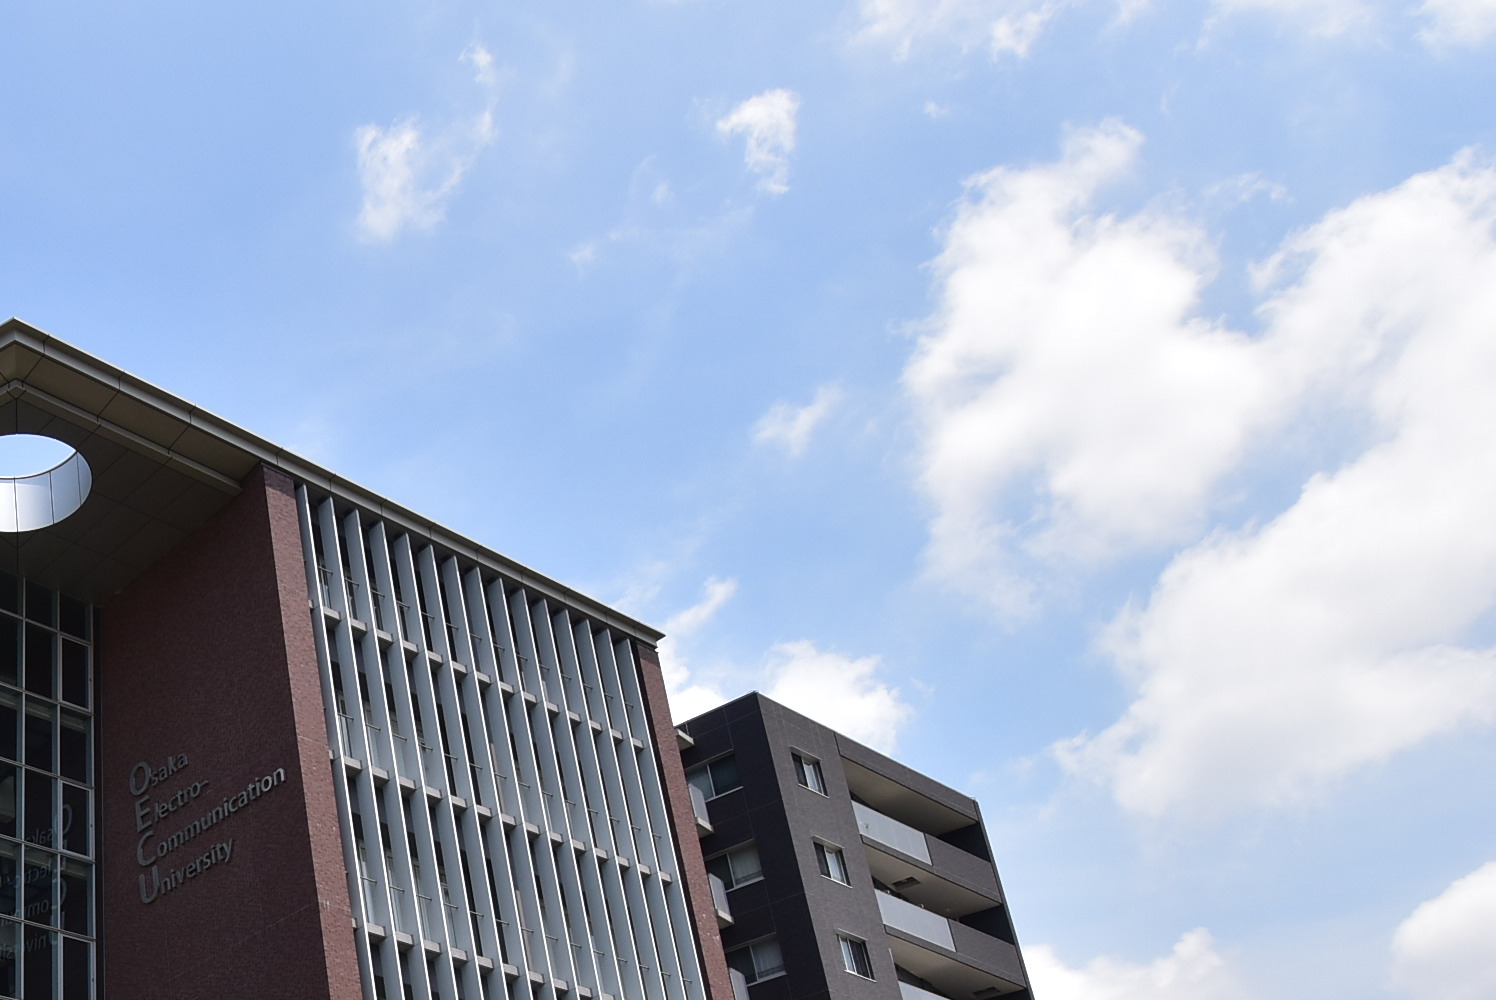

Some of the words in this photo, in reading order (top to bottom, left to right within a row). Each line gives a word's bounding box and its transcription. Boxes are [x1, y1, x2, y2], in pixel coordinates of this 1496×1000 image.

[129, 753, 189, 796] Osaka
[135, 779, 209, 832] Electro-
[136, 768, 286, 867] Communication
[138, 838, 233, 903] University
